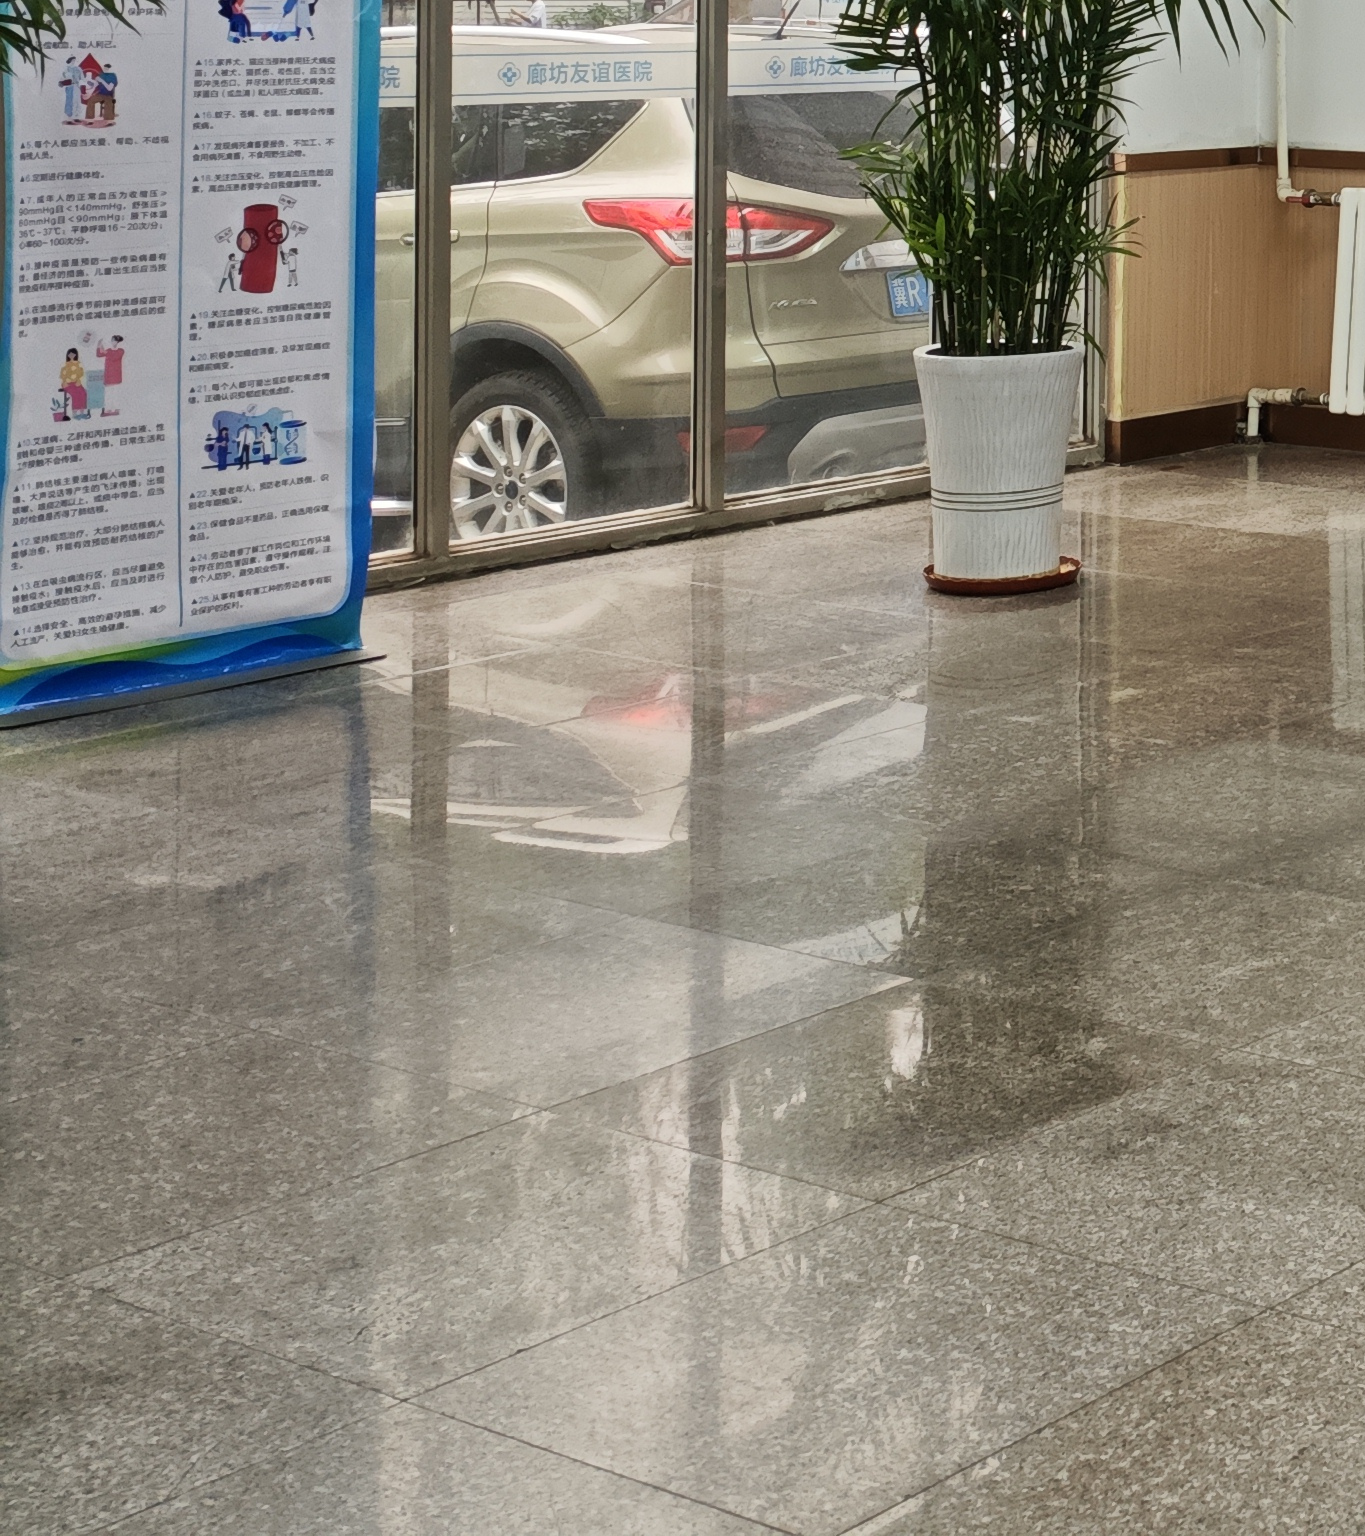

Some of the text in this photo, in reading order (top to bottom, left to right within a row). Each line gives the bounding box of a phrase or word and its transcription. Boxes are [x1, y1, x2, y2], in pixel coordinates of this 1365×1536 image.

[526, 61, 653, 86] 廊坊友谊医院
[790, 56, 894, 77] 廊坊友
